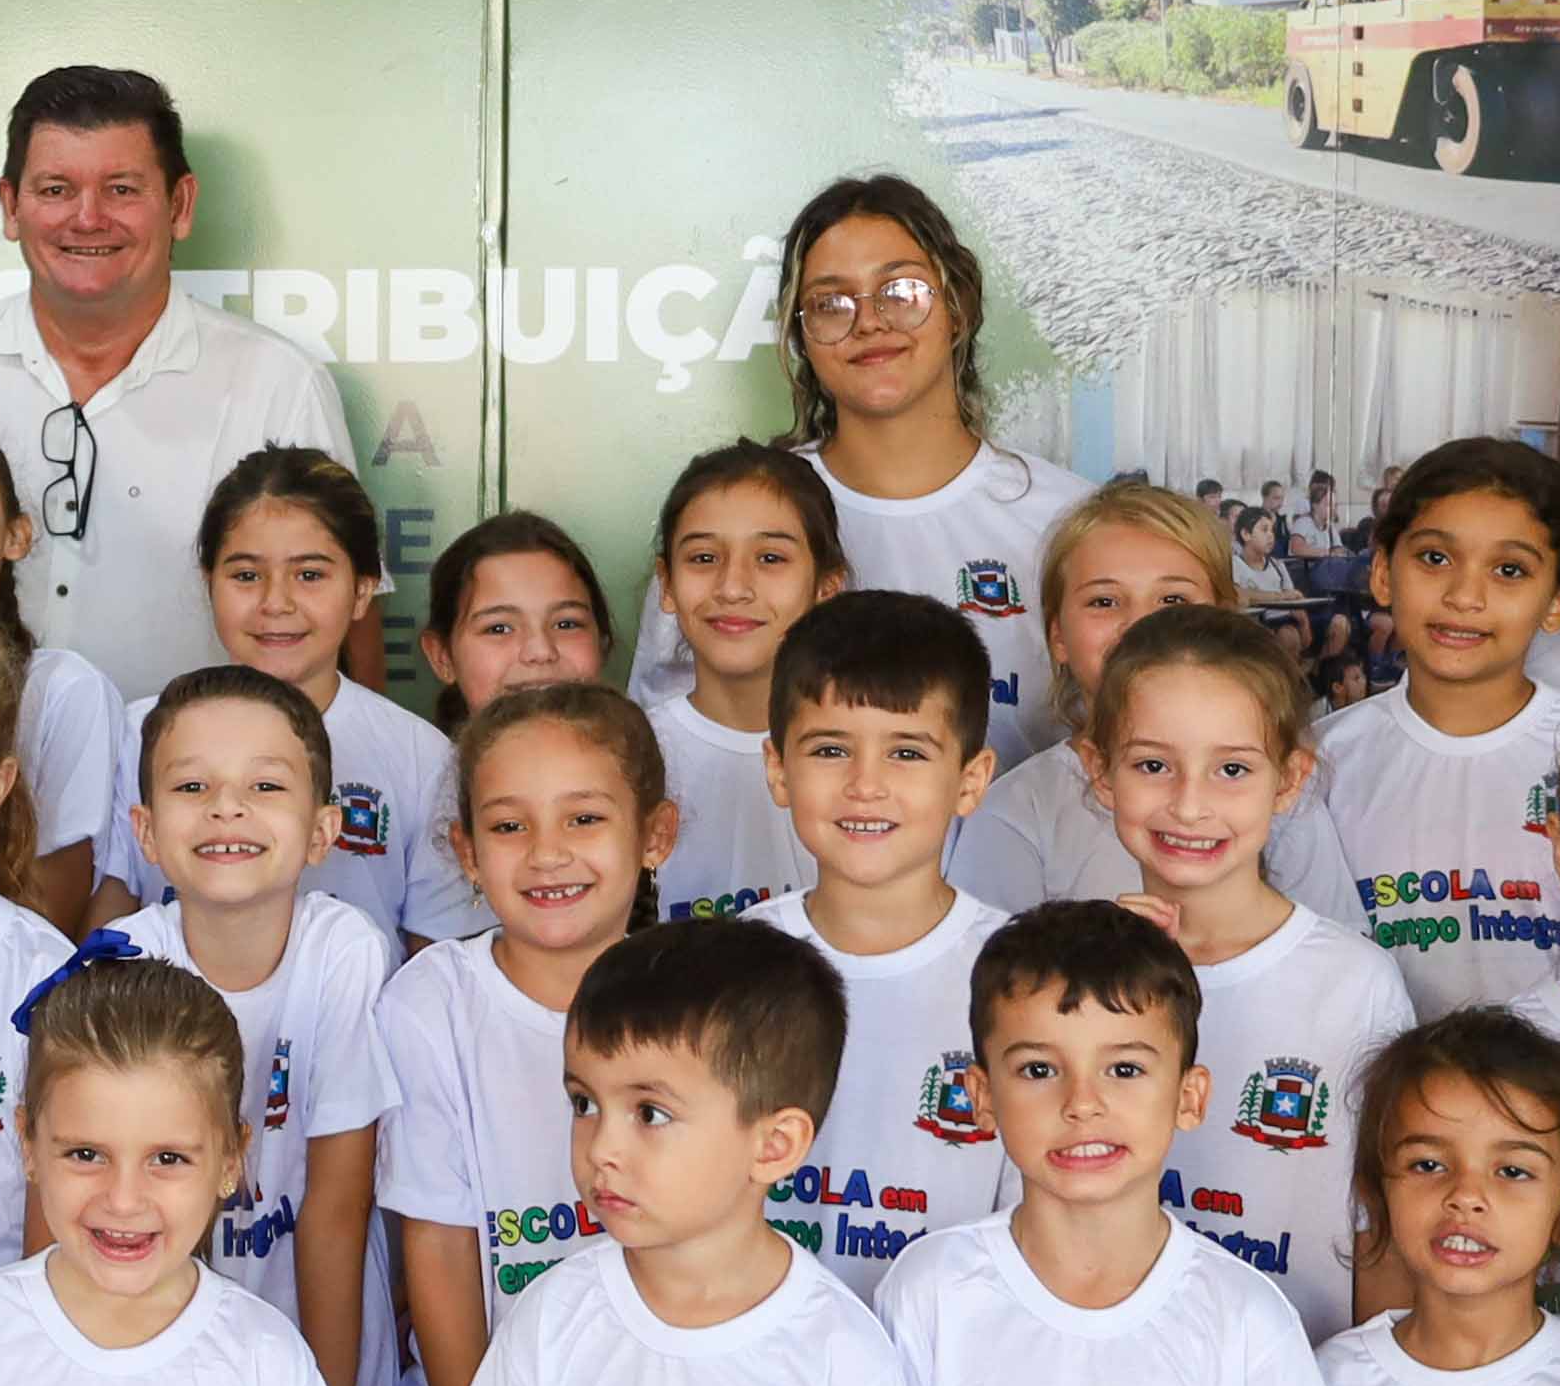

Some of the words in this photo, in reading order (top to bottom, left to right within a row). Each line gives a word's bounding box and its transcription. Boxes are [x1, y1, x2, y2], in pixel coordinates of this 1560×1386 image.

[1357, 867, 1497, 915] ESCOLA
[1500, 879, 1542, 902] em
[1369, 911, 1462, 954] empo
[879, 1184, 928, 1213] em
[1191, 1184, 1244, 1217] em
[486, 1201, 605, 1248] ESCOL
